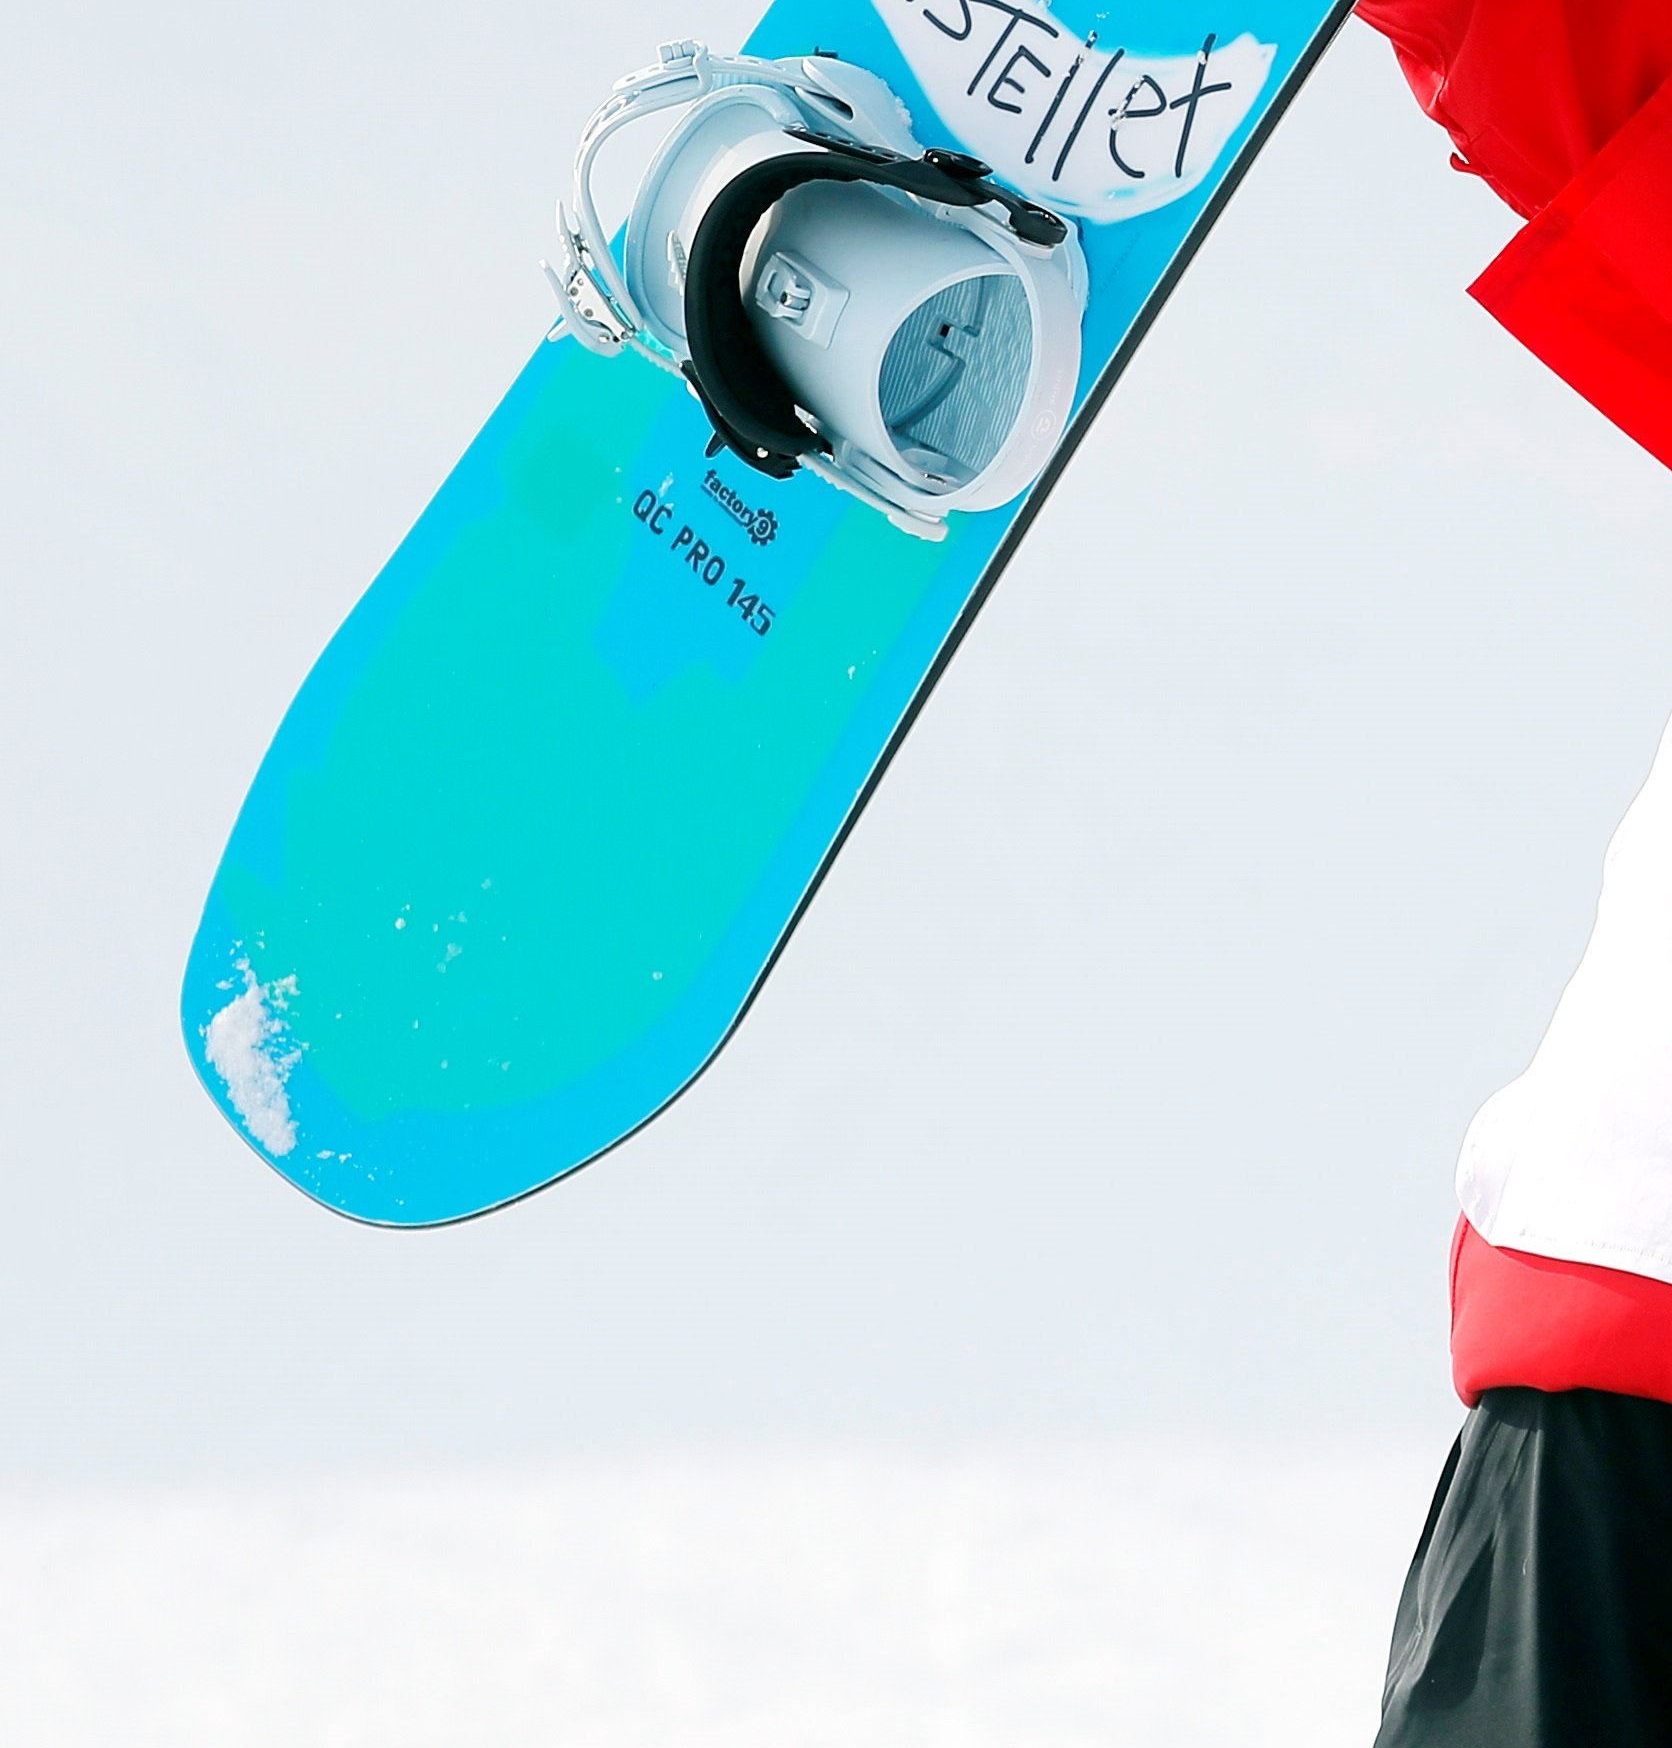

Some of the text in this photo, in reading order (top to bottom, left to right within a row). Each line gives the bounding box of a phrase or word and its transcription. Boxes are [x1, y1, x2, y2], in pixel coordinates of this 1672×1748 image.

[632, 488, 673, 536] QC
[670, 524, 726, 586] PRO
[726, 577, 777, 637] 145
